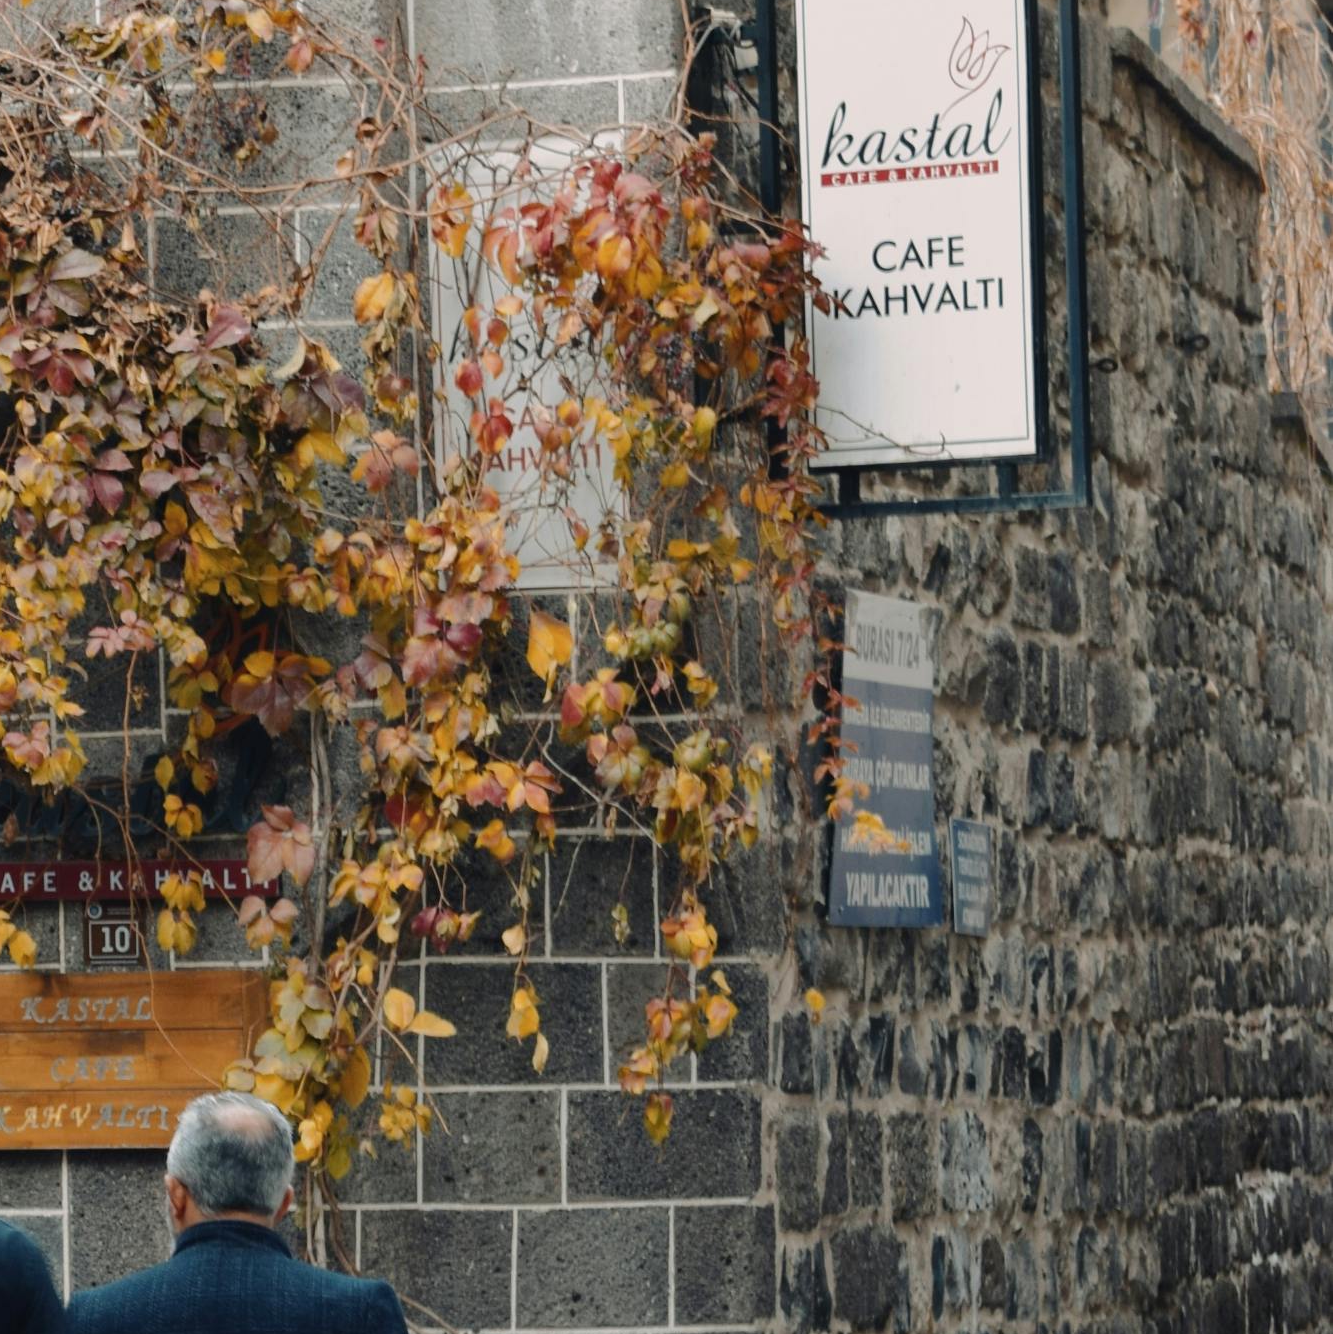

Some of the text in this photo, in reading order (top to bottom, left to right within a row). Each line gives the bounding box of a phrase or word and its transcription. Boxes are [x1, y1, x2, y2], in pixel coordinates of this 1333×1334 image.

[822, 87, 1012, 169] kastal
[830, 172, 878, 187] CAFE
[905, 161, 995, 182] KAHVALTI
[872, 235, 965, 273] CAFE
[833, 277, 1004, 320] KAHVALTI
[78, 870, 94, 891] &
[101, 925, 130, 953] 10
[20, 996, 152, 1024] KASTAL
[50, 1055, 136, 1083] CAFE
